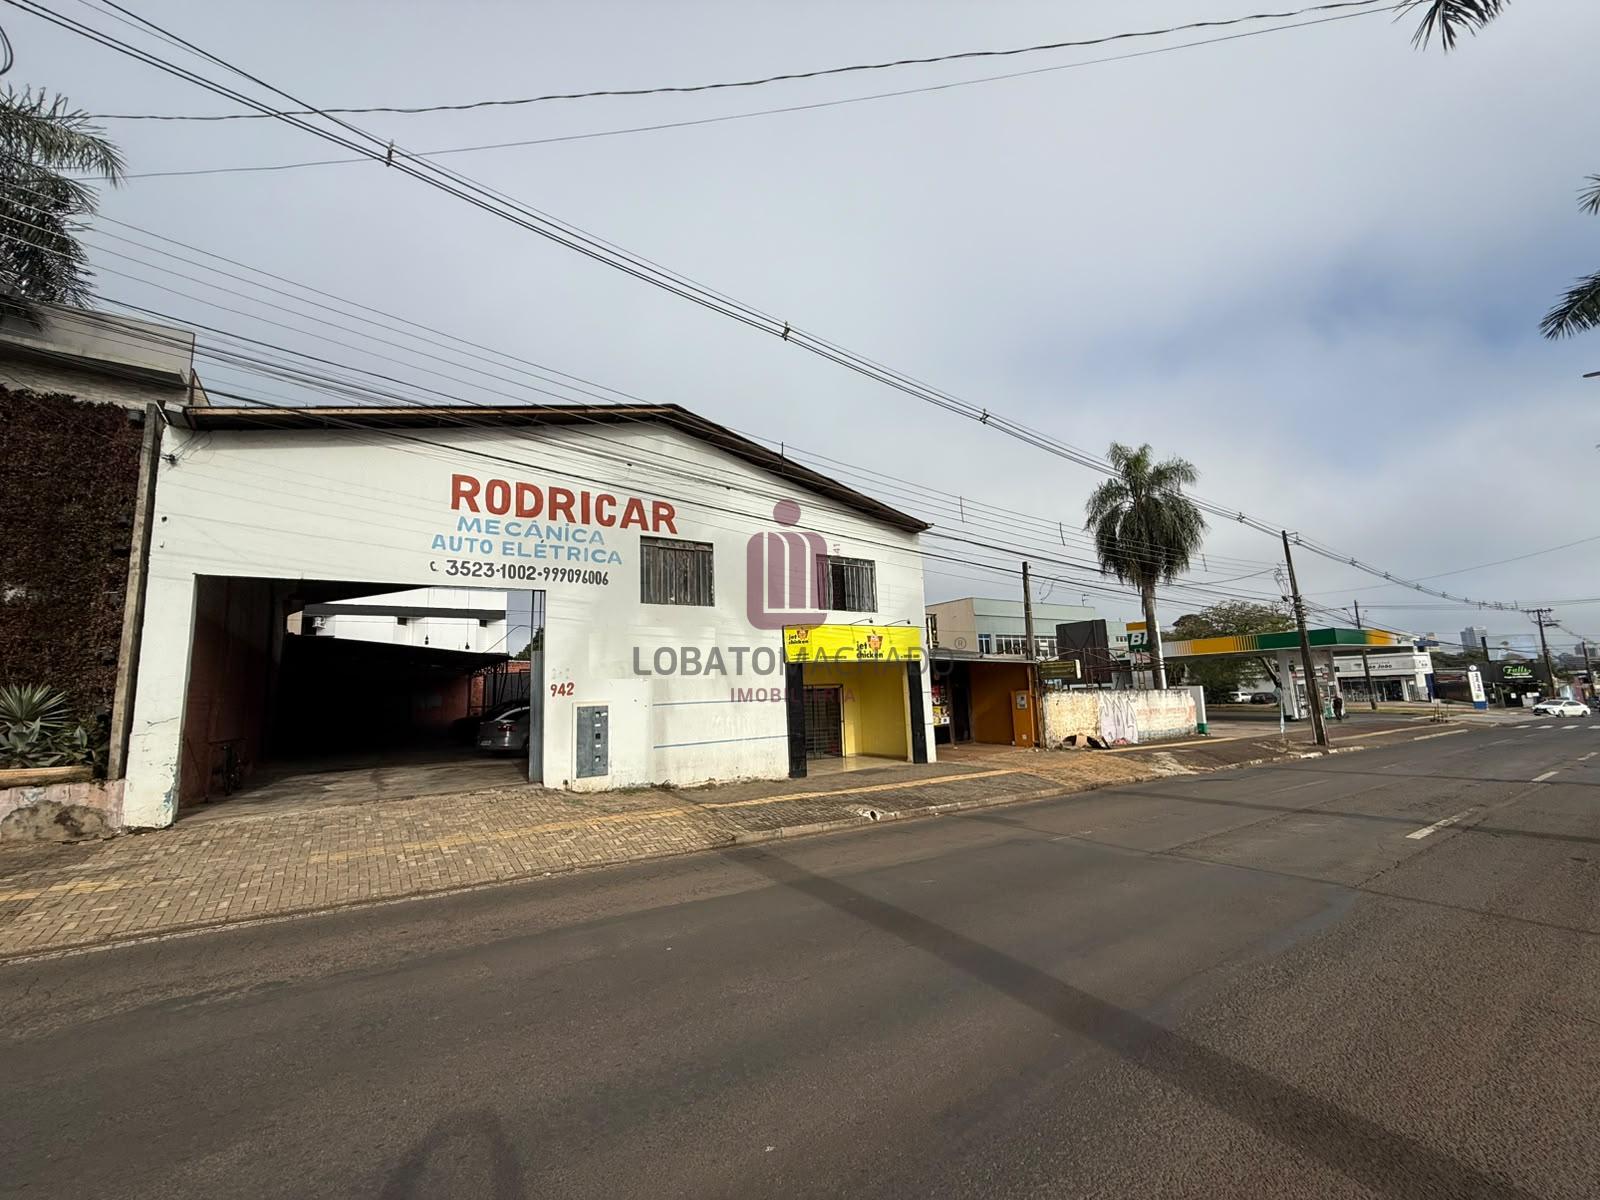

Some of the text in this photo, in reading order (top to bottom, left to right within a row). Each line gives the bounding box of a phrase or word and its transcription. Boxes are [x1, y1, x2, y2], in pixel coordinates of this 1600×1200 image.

[450, 473, 678, 535] RODRICAR
[457, 515, 605, 546] MECÂNICA
[431, 533, 622, 565] AUTO ELÉTRICA
[856, 641, 867, 651] jet
[856, 650, 883, 659] chicken
[550, 682, 575, 697] 942
